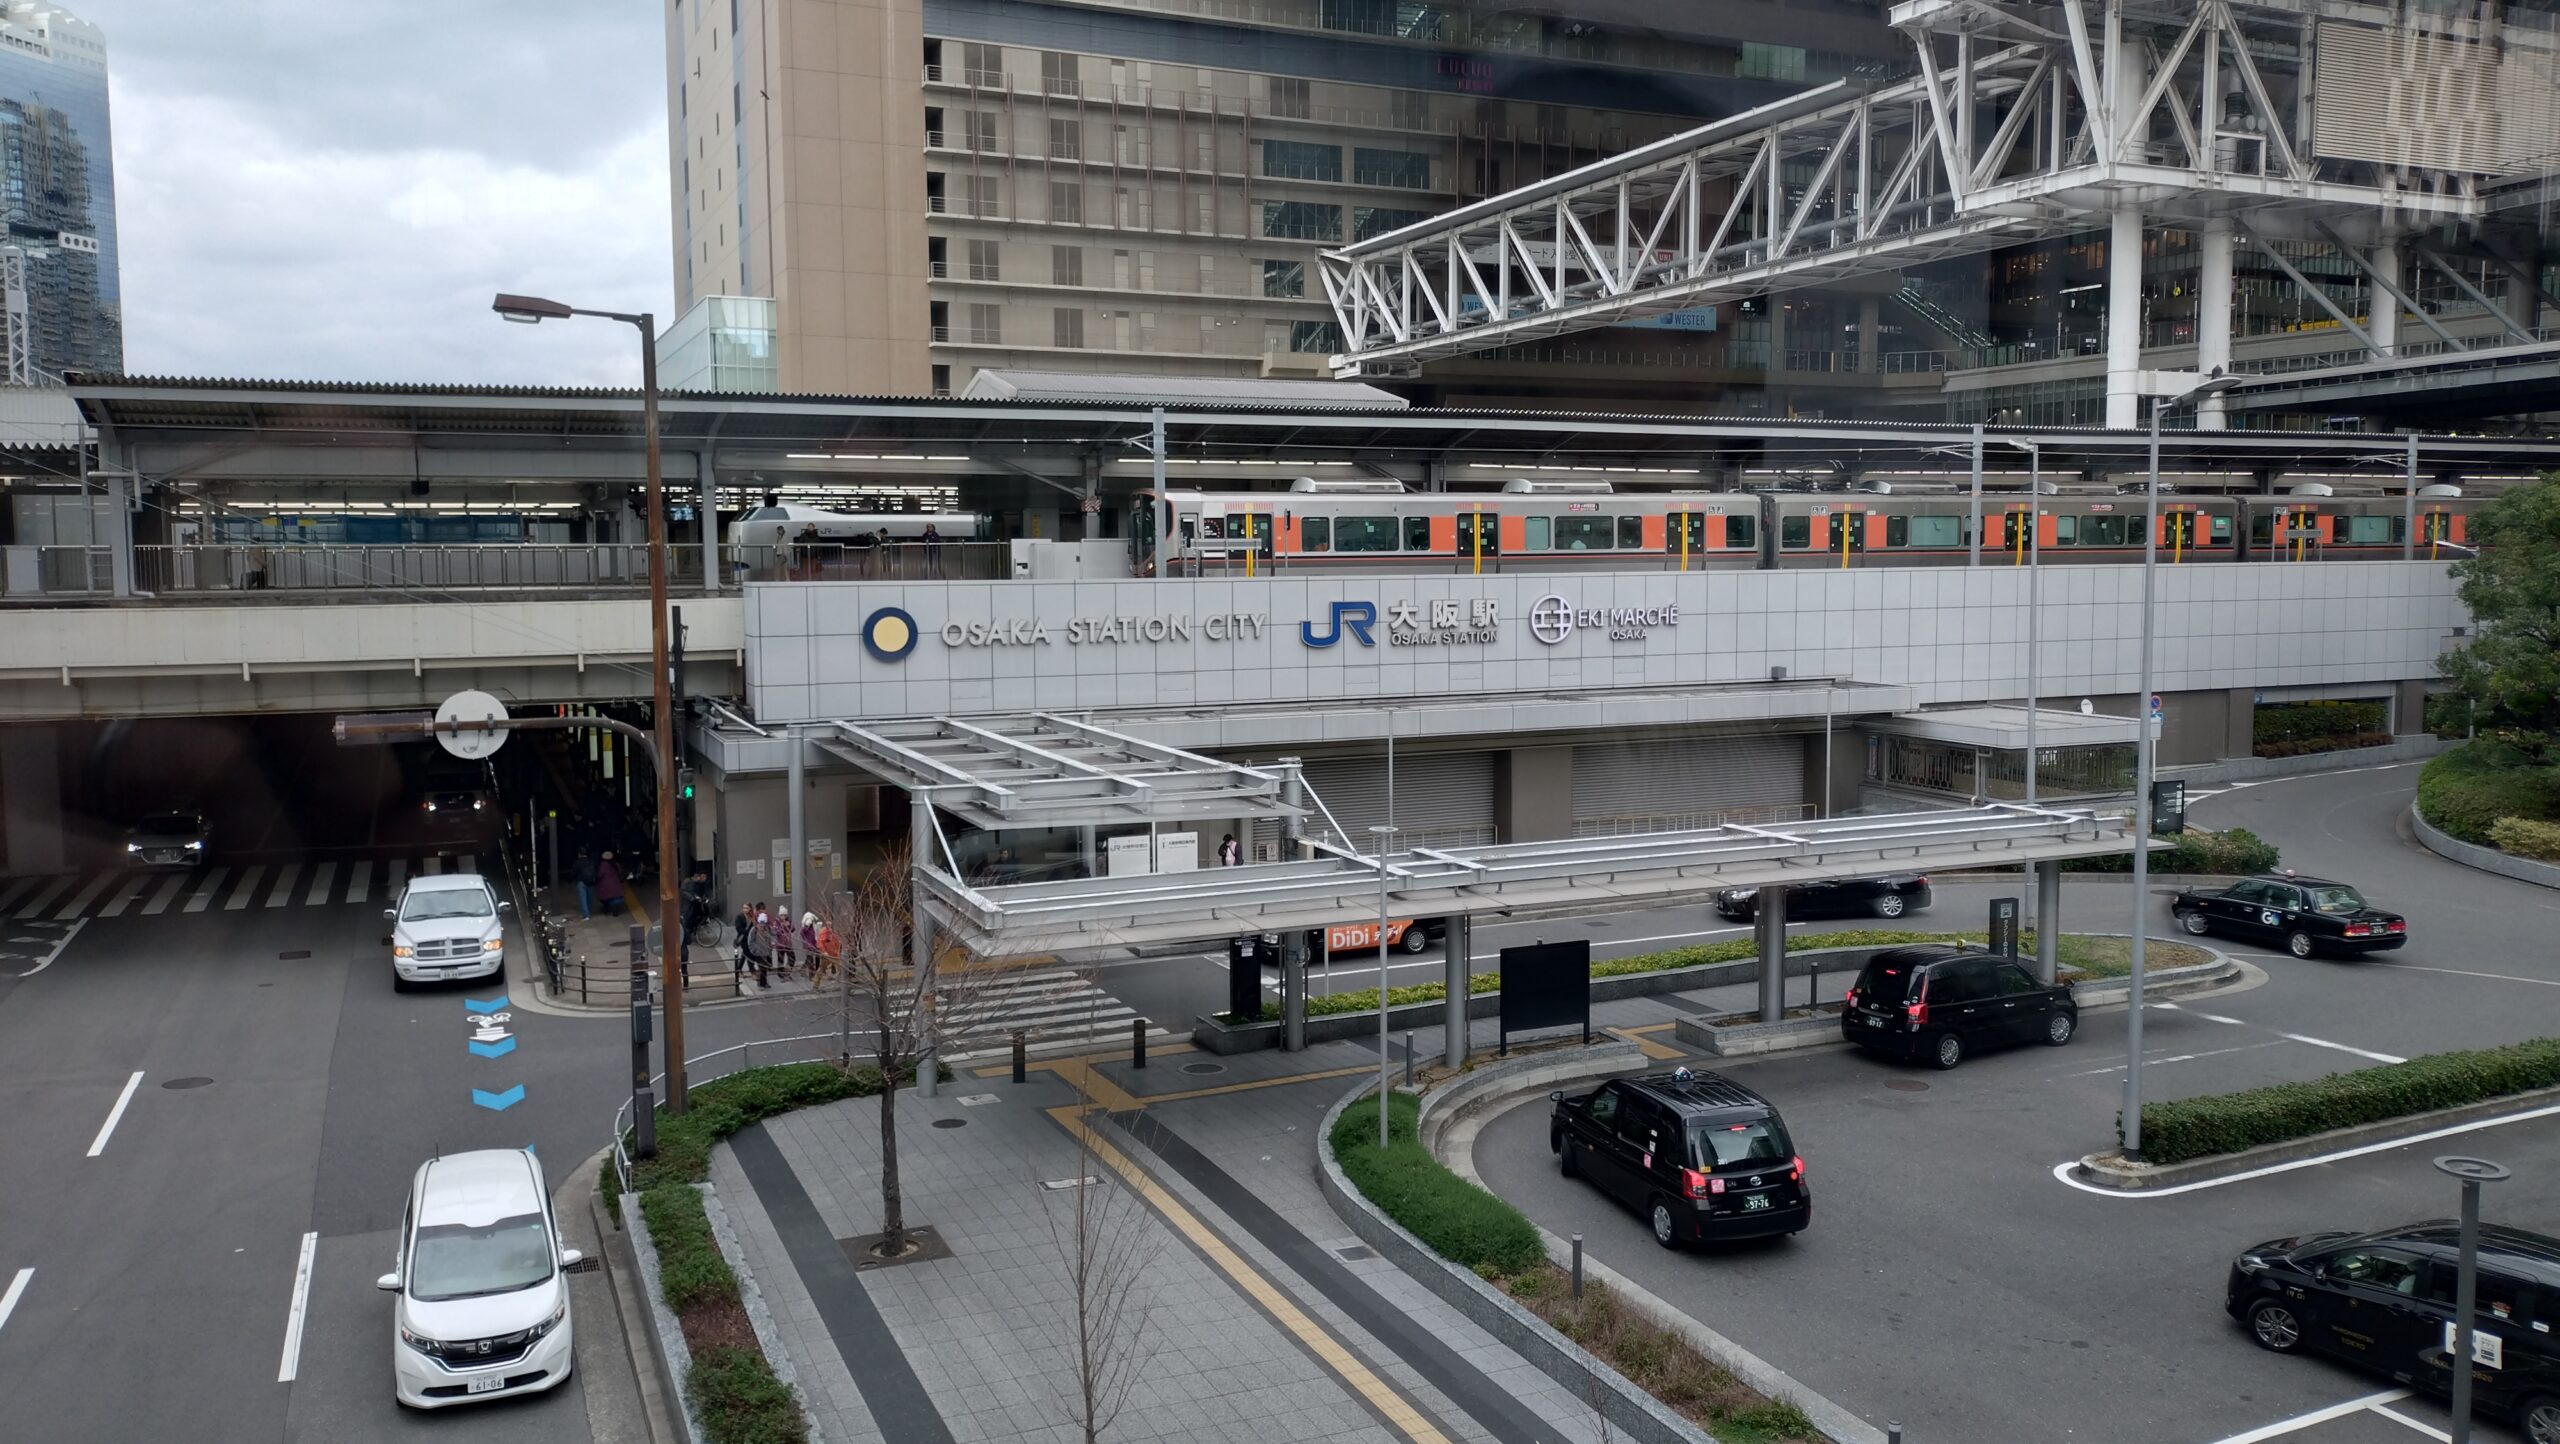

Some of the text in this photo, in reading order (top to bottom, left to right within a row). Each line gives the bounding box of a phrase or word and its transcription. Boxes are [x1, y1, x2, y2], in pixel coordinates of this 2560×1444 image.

[1674, 313, 1706, 327] WESTER
[1389, 599, 1500, 630] 大阪駅
[1576, 602, 1680, 628] EKI MARCHÉ
[941, 612, 1267, 648] OSAKA STATION CITY
[1300, 601, 1377, 648] JR
[1391, 630, 1498, 646] OSAKA STATION
[1610, 629, 1648, 641] OSAKA
[1332, 927, 1369, 949] DiDi
[1749, 1199, 1769, 1210] 97-76
[475, 1378, 503, 1391] 61-06
